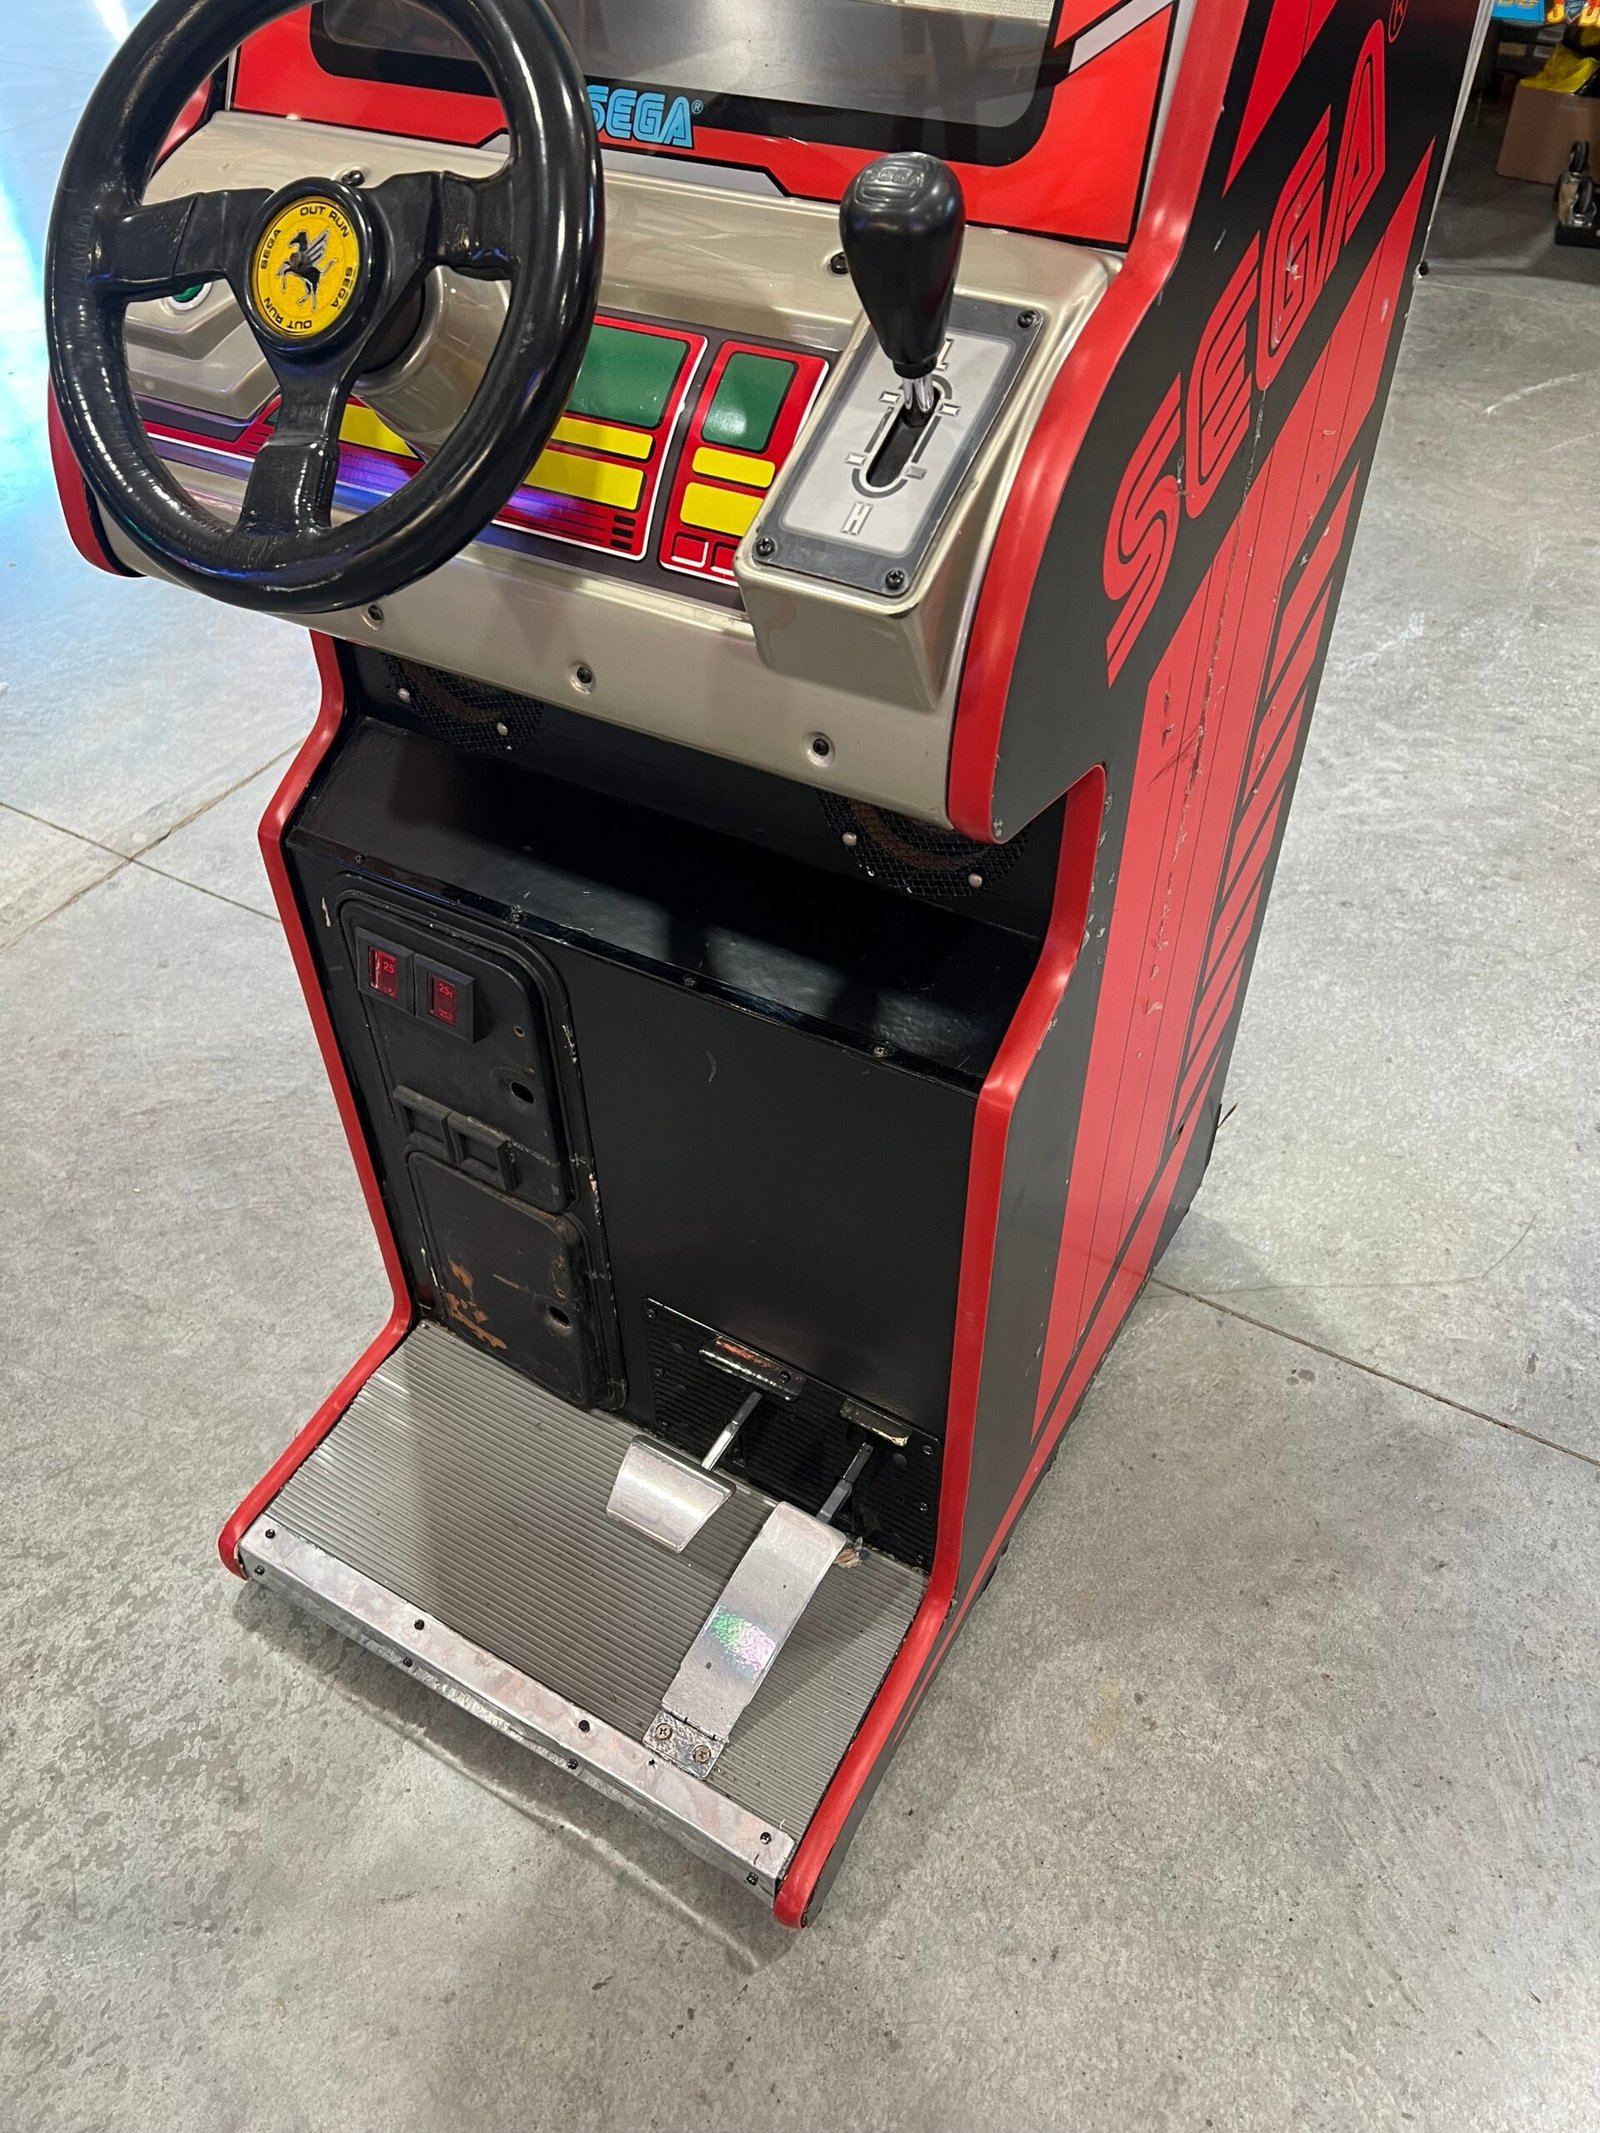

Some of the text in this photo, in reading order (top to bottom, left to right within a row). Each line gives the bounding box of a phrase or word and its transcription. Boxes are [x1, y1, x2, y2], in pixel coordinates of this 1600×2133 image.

[299, 206, 350, 238] OUT RUN
[260, 228, 282, 270] SEGA
[331, 266, 354, 309] SEGA
[263, 297, 313, 330] OUT RUN
[840, 501, 874, 536] H
